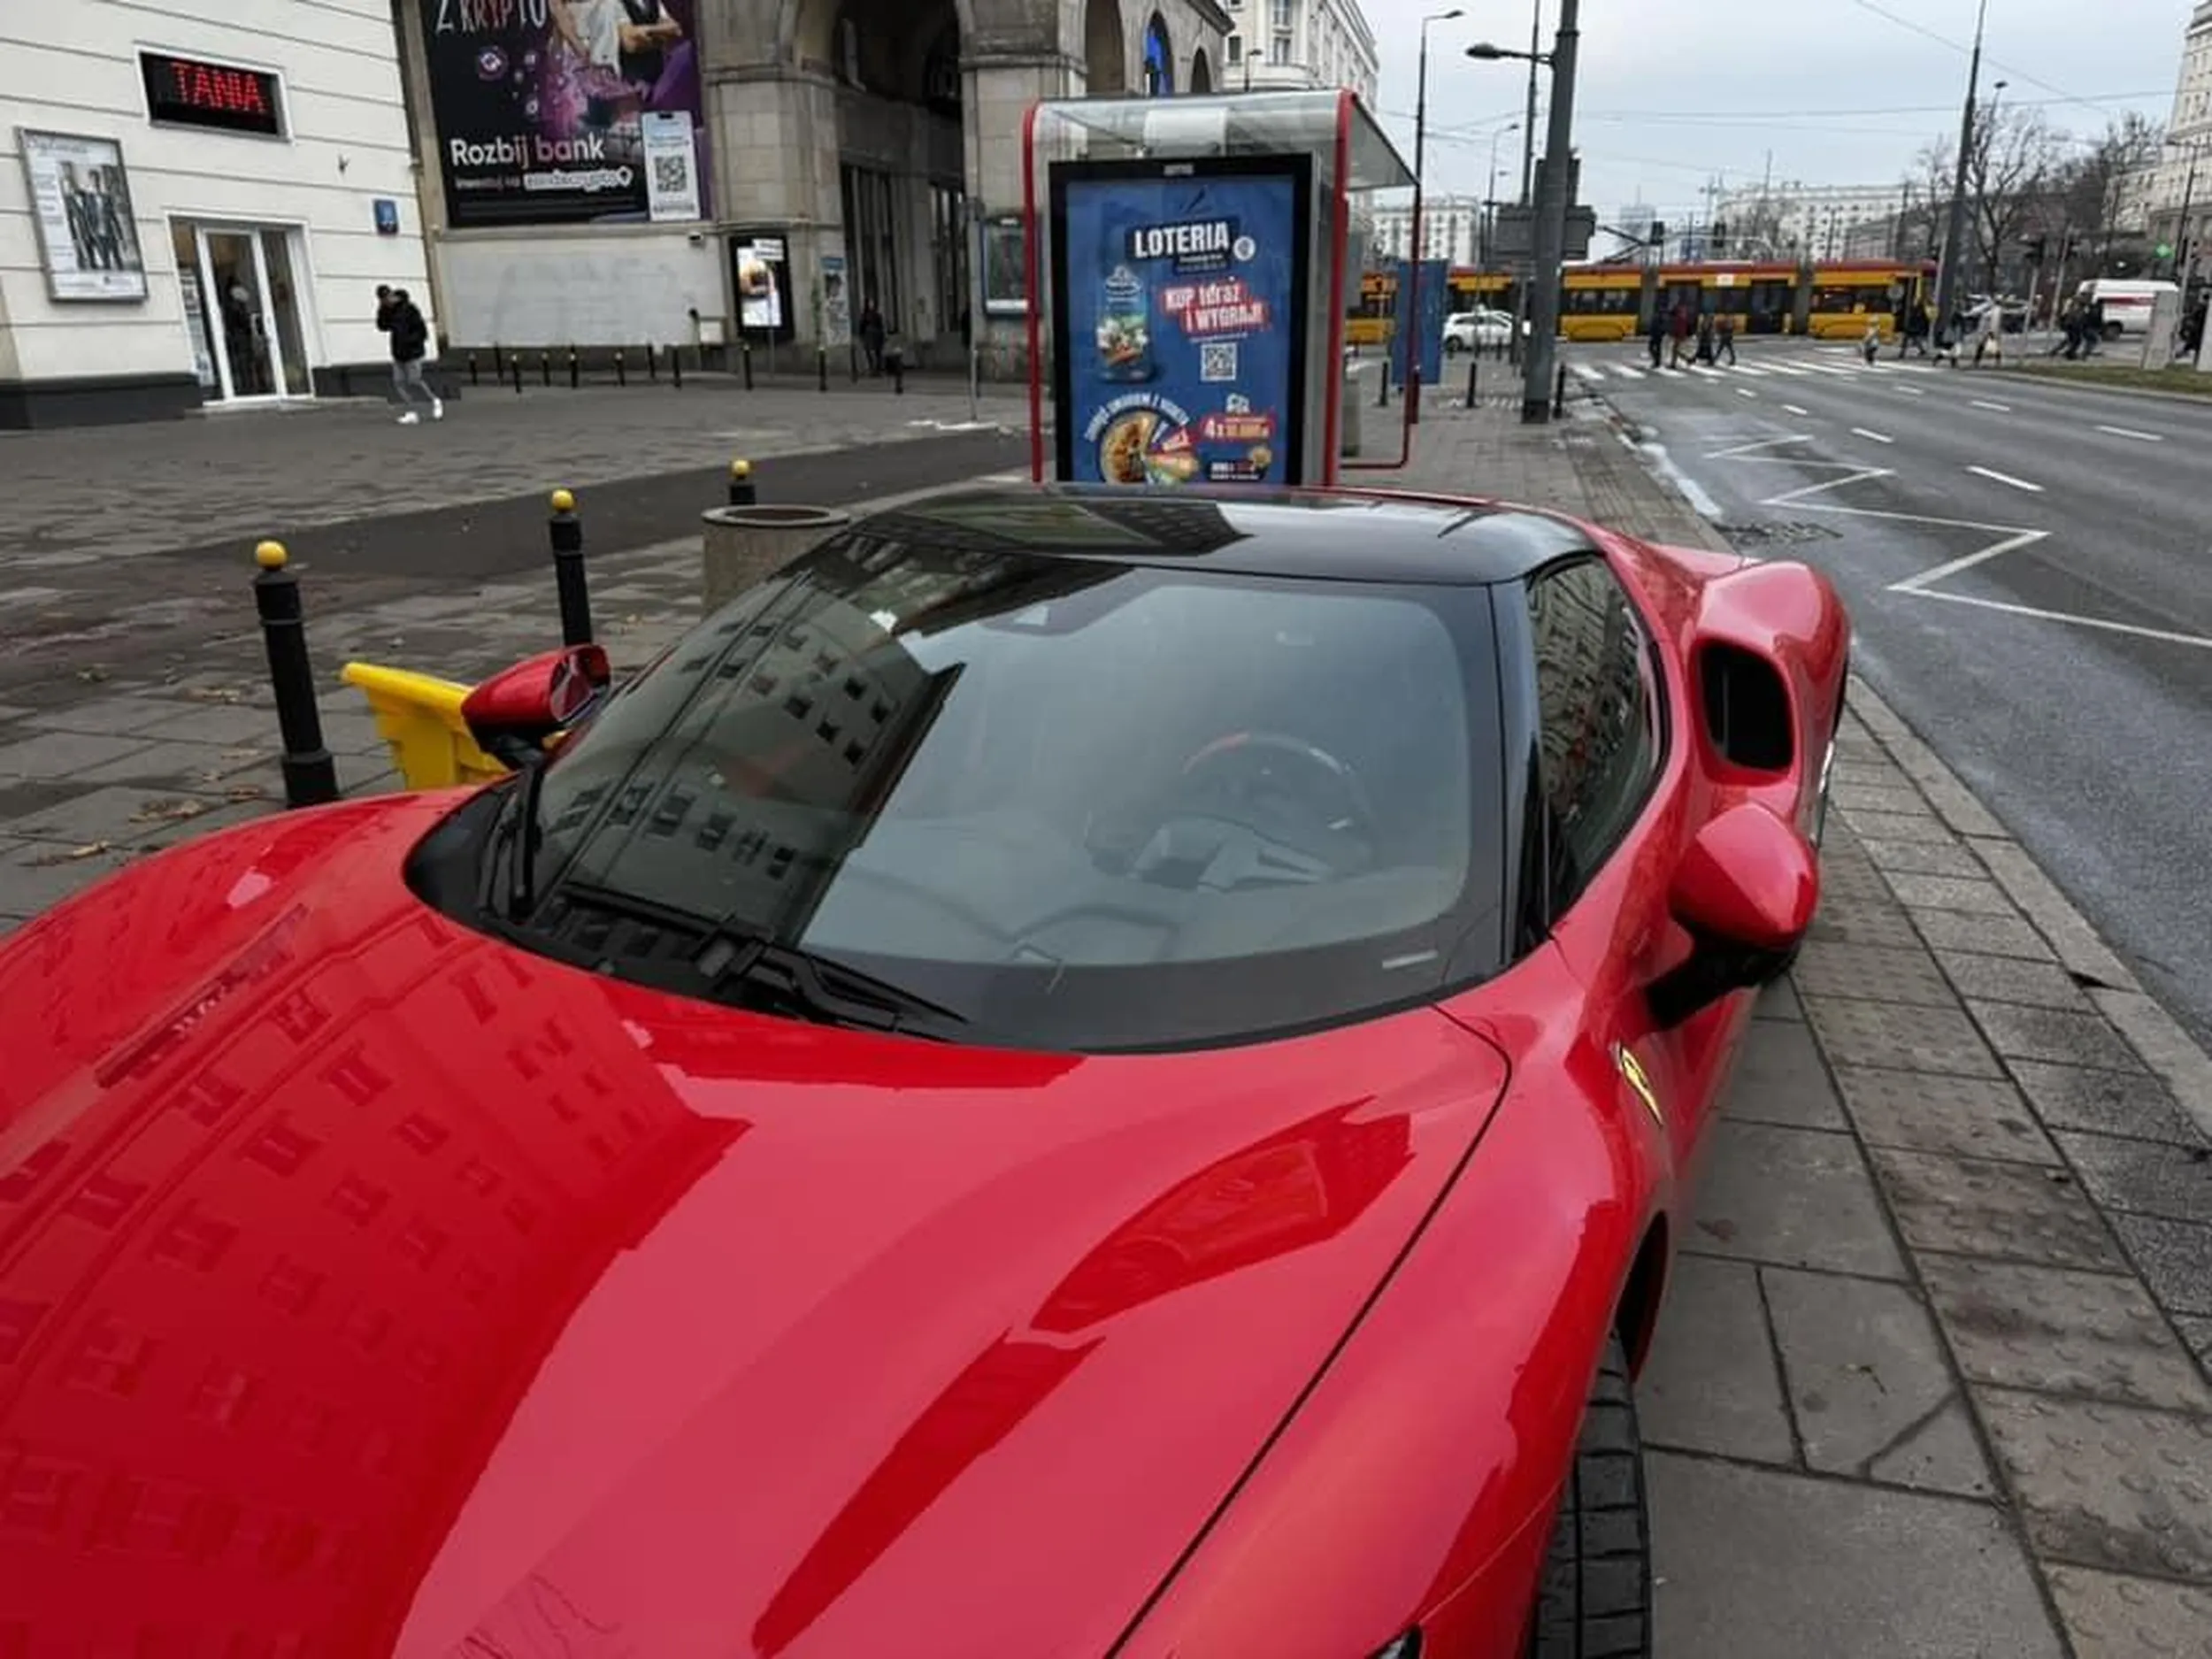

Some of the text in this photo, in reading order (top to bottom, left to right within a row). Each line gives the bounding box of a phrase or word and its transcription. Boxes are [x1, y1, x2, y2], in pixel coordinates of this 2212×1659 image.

[170, 62, 266, 113] TANIA
[449, 131, 605, 170] Rozbij bank
[1134, 221, 1230, 258] LOTERIA
